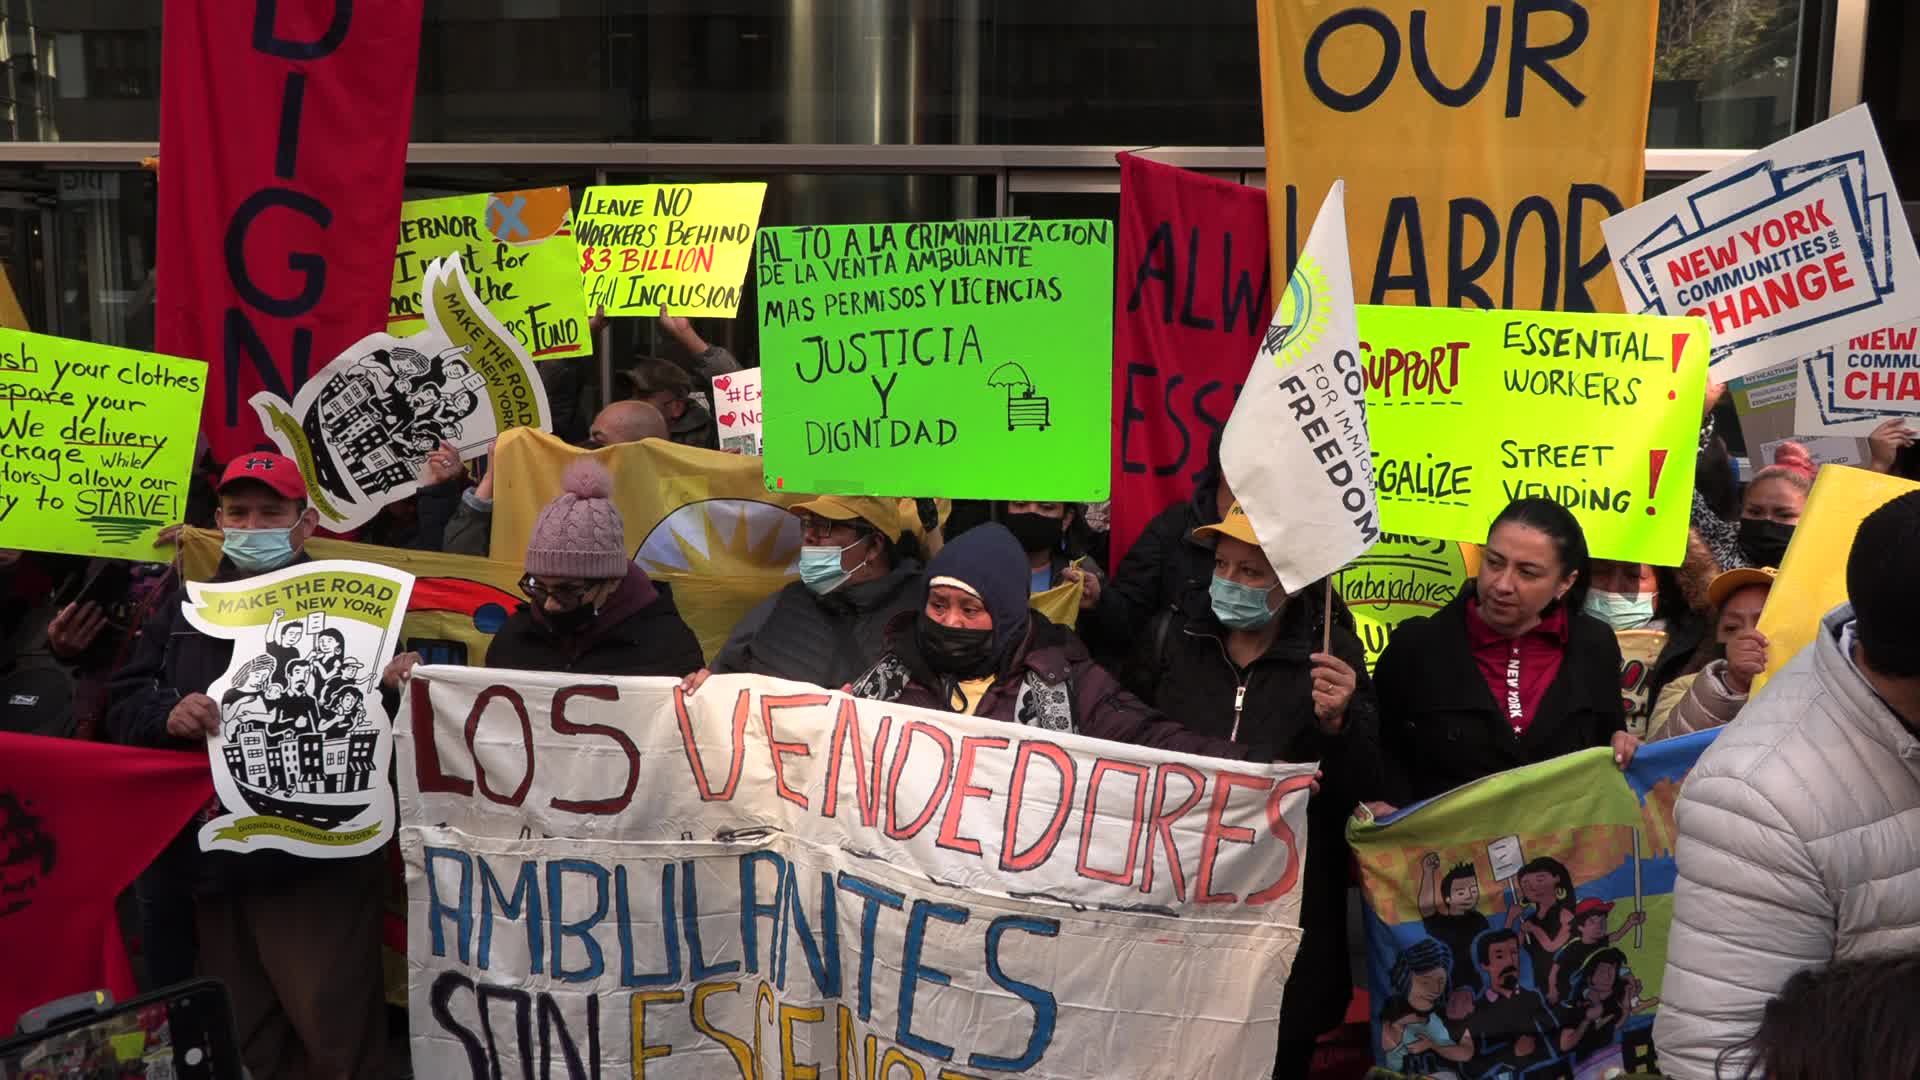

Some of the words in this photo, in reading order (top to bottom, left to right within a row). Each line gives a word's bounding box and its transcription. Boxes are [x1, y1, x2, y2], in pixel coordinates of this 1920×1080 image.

[1304, 0, 1590, 117] OUR
[583, 191, 644, 217] LEAVE
[653, 188, 693, 217] NO
[224, 0, 353, 452] DIGN
[398, 215, 483, 245] ERNOR
[576, 219, 658, 248] WORKERS
[665, 220, 750, 246] BEHIND
[844, 228, 862, 256] A
[869, 225, 897, 252] LA
[905, 220, 1107, 250] CRIMINALIZACION
[1667, 235, 1739, 287] NEW
[1739, 198, 1833, 256] YORK
[395, 251, 416, 284] I
[420, 243, 483, 275] wt
[491, 242, 530, 271] for
[580, 244, 612, 273] $3
[619, 244, 714, 273] BILLION
[759, 264, 784, 288] DE
[795, 263, 818, 284] LA
[823, 252, 897, 281] VENTA
[906, 246, 1033, 274] AMBULANTE
[1677, 236, 1828, 306] COMMUNITIES
[1828, 229, 1841, 250] FOR
[474, 275, 519, 305] the
[619, 274, 745, 309] INCLUSION
[764, 297, 815, 328] MAS
[824, 284, 926, 316] PERMISOS
[930, 278, 946, 307] Y
[951, 277, 1062, 305] LICENCIAS
[524, 302, 578, 352] FUND
[1849, 327, 1918, 350] NEW
[0, 342, 38, 370] sh
[51, 360, 110, 390] your
[117, 362, 200, 392] clothes
[443, 292, 485, 342] MAKE
[482, 337, 515, 372] THE
[506, 373, 533, 427] ROAD
[796, 324, 983, 383] JUSTICIA
[1359, 341, 1470, 398] SUPPORT
[476, 356, 504, 388] NEW
[497, 391, 515, 431] YORK
[871, 372, 898, 419] Y
[1306, 363, 1338, 407] FOR
[1504, 369, 1642, 406] WORKERS
[1844, 371, 1920, 401] CHA
[82, 394, 146, 423] your
[1123, 363, 1245, 483] ESS
[60, 416, 167, 468] delivery
[805, 417, 957, 455] DIGNIDAD
[1501, 439, 1614, 468] STREET
[68, 467, 132, 488] allow
[140, 478, 177, 490] our
[1279, 375, 1378, 544] FREEDOM
[36, 485, 64, 511] to
[75, 489, 177, 520] STARVE!
[217, 590, 279, 614] MAKE
[282, 578, 326, 600] THE
[331, 578, 393, 601] ROAD
[296, 597, 338, 611] NEW
[344, 597, 388, 619] YORK
[1330, 567, 1457, 610] Trabajadores
[1506, 659, 1520, 688] NEW
[1507, 690, 1523, 718] YORK
[410, 680, 640, 814] LOS
[673, 685, 1313, 905] VENDEDORES
[424, 847, 1062, 1072] AMBULANTES
